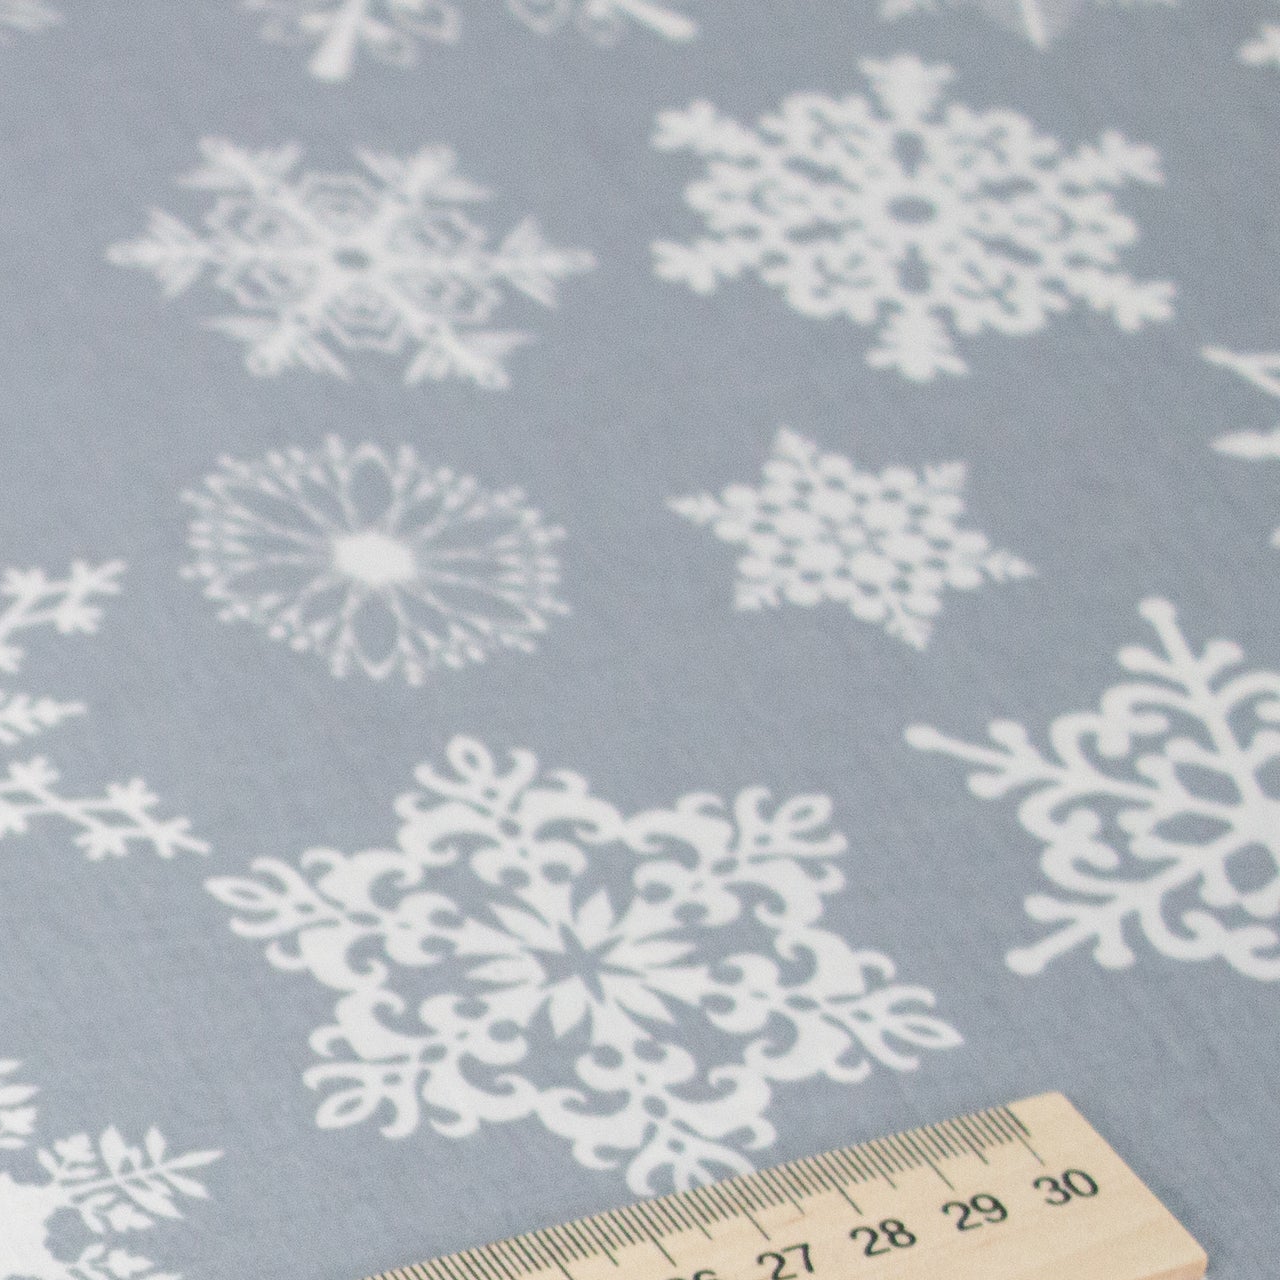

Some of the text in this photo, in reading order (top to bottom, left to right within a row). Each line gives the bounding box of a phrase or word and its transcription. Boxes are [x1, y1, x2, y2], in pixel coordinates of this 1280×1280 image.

[849, 1219, 917, 1258] 28
[941, 1193, 1008, 1232] 29
[1032, 1168, 1099, 1206] 30
